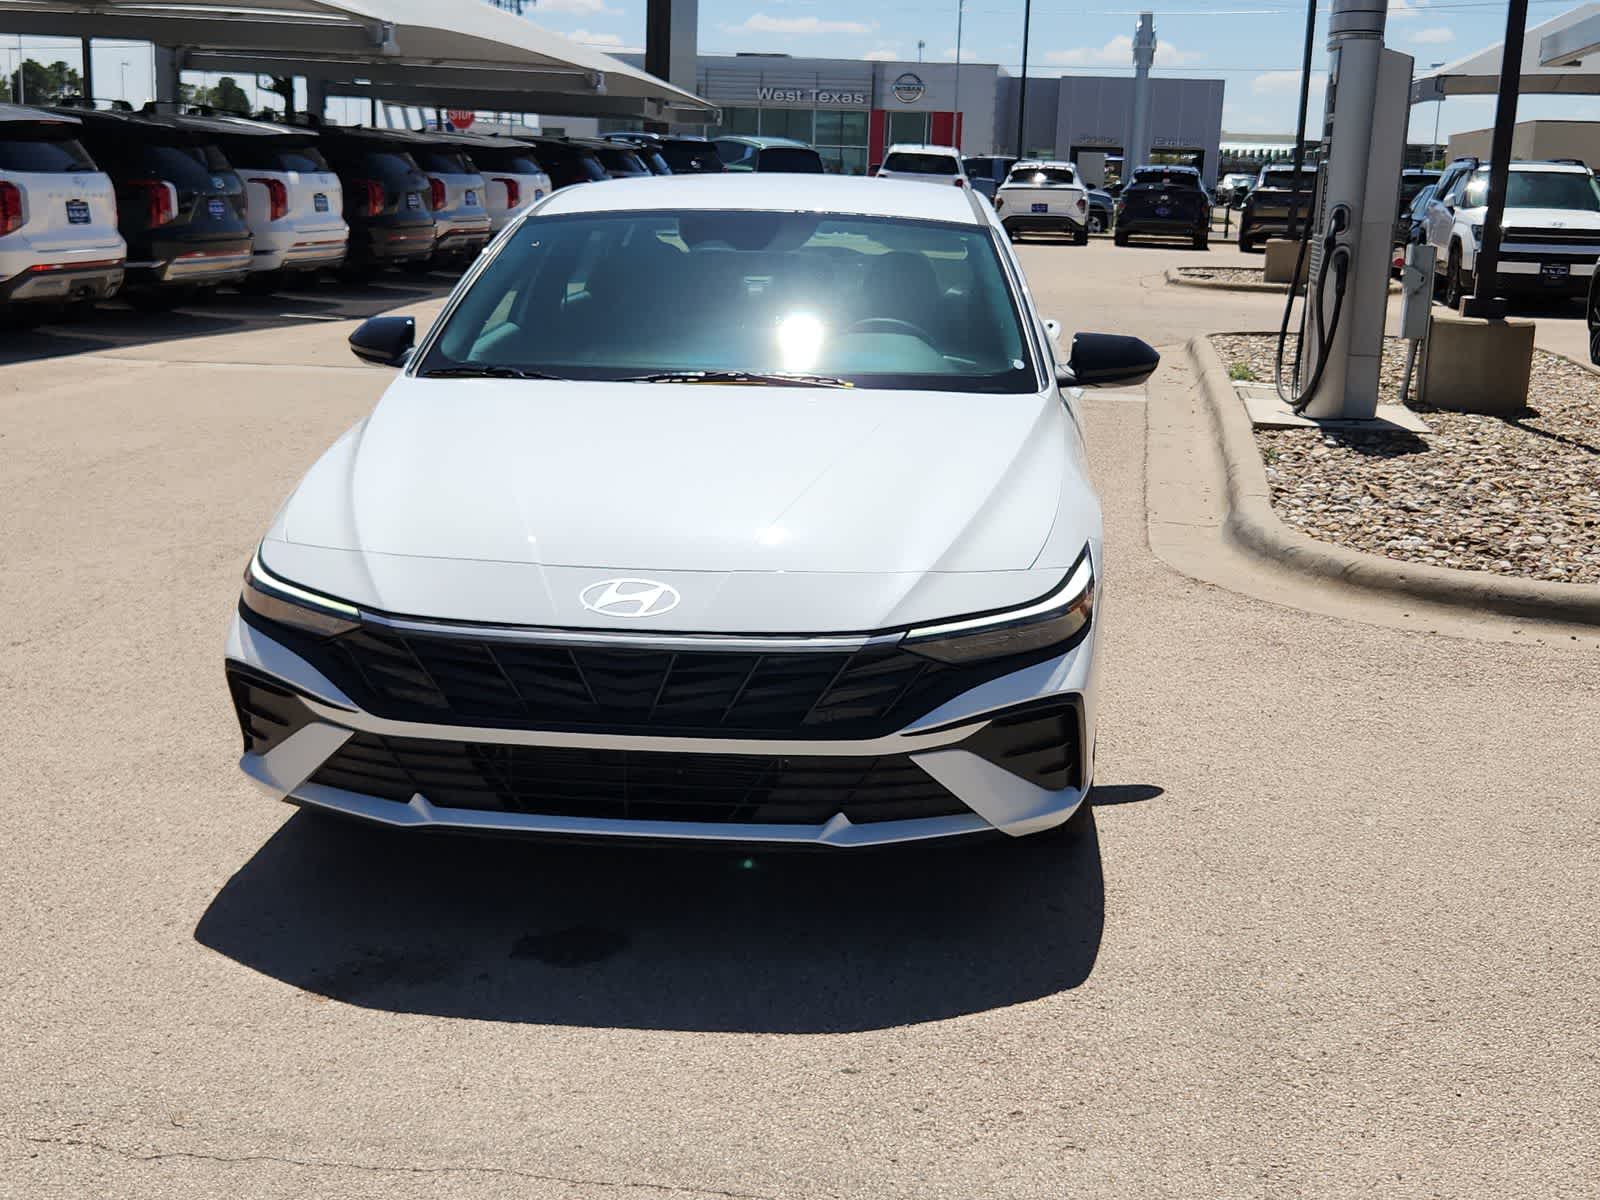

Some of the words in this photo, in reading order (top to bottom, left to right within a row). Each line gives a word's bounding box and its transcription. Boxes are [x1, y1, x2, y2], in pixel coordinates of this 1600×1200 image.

[756, 87, 802, 101] West
[808, 89, 865, 104] Texas
[448, 109, 471, 121] STOP
